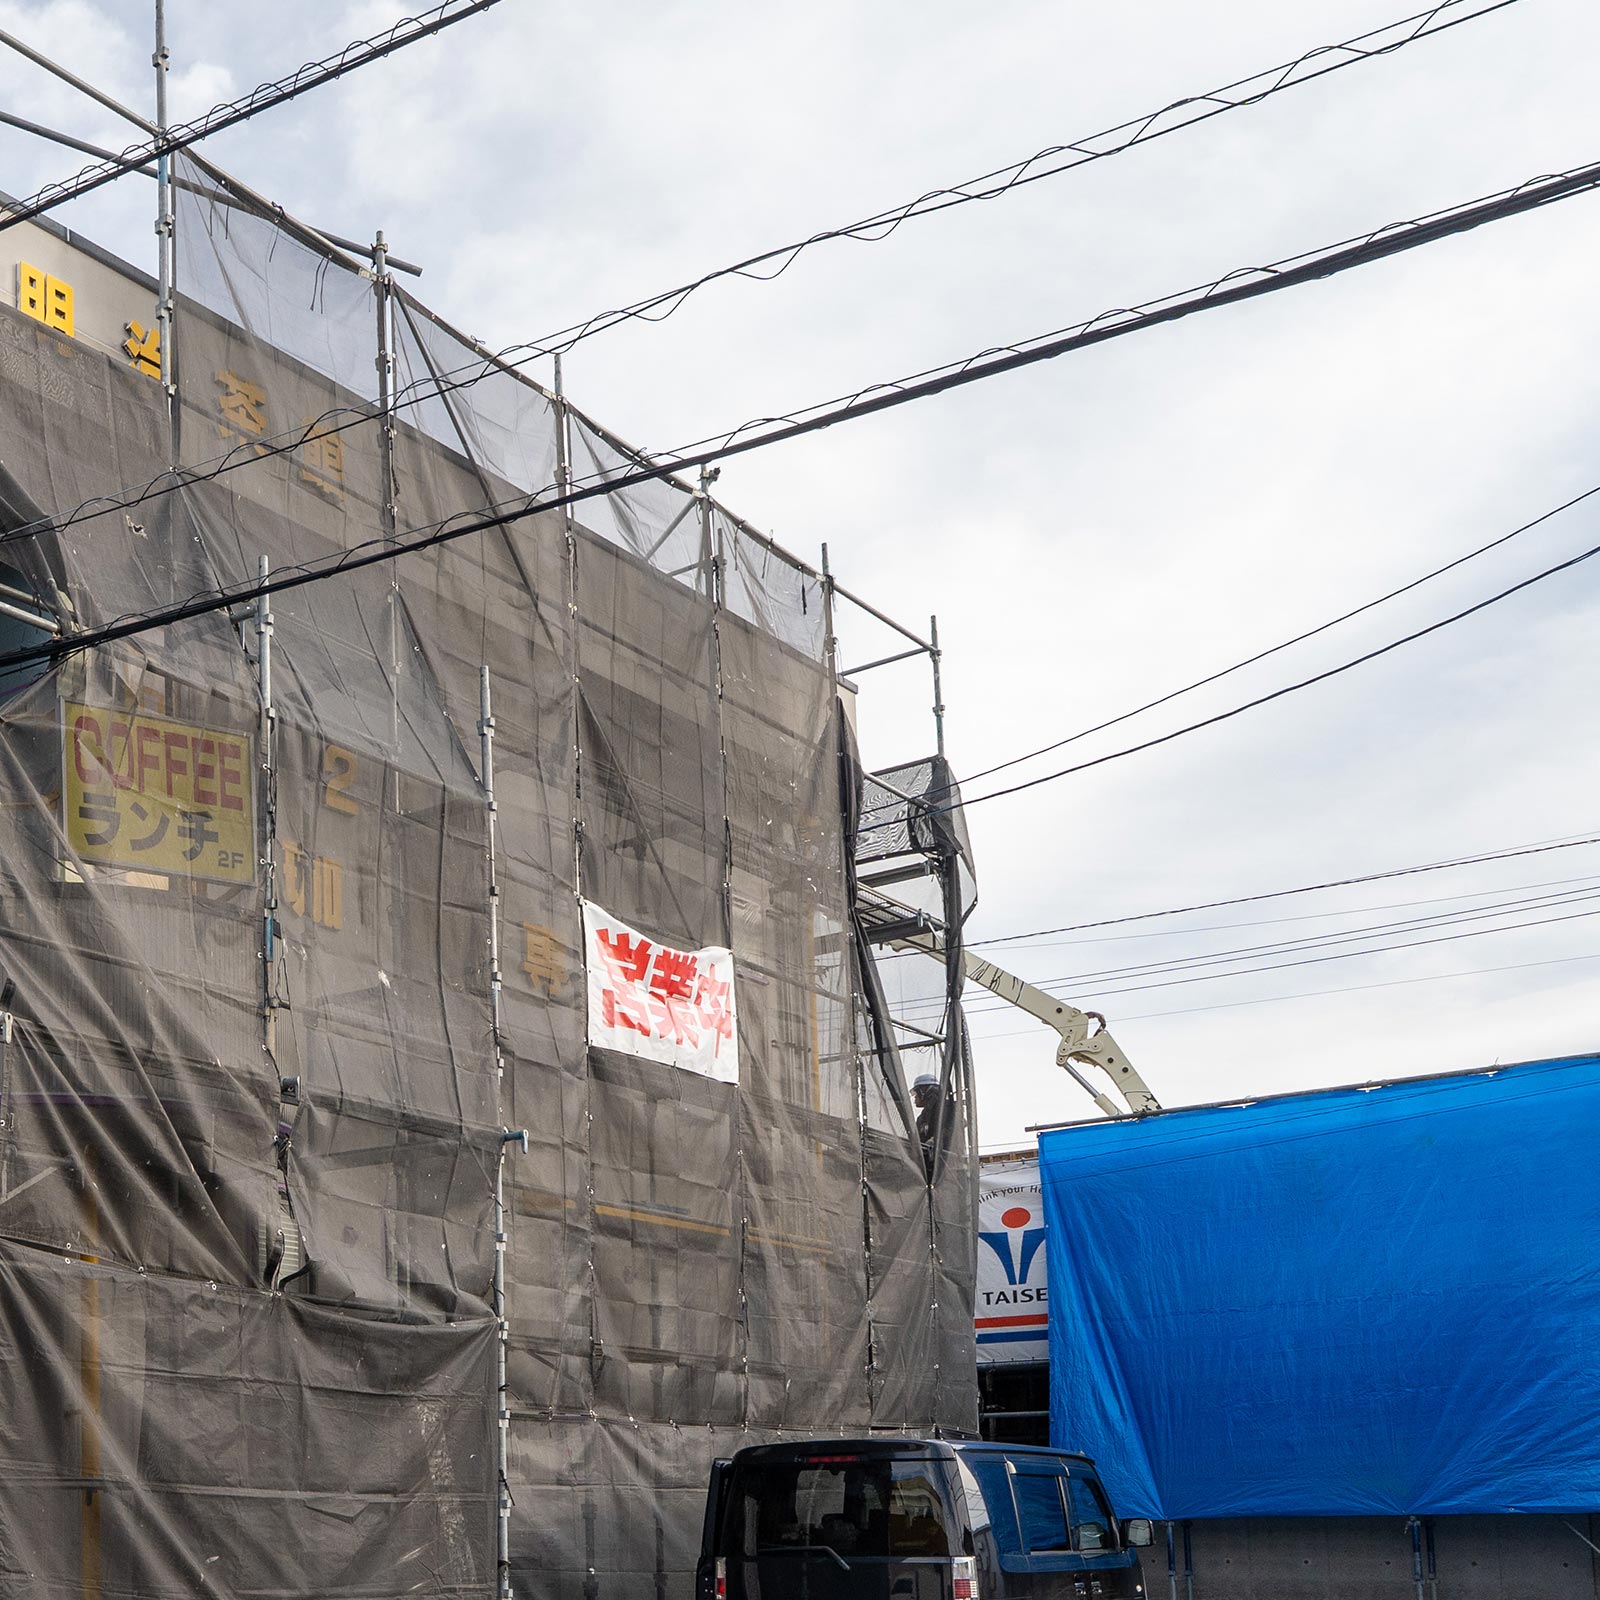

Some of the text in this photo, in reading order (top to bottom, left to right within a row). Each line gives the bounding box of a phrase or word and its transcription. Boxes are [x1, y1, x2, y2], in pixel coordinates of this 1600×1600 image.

[74, 715, 243, 811] COFFEE
[79, 792, 219, 861] ランチ
[218, 850, 244, 869] 2F
[595, 928, 732, 1058] 営業中
[1001, 1186, 1025, 1198] your
